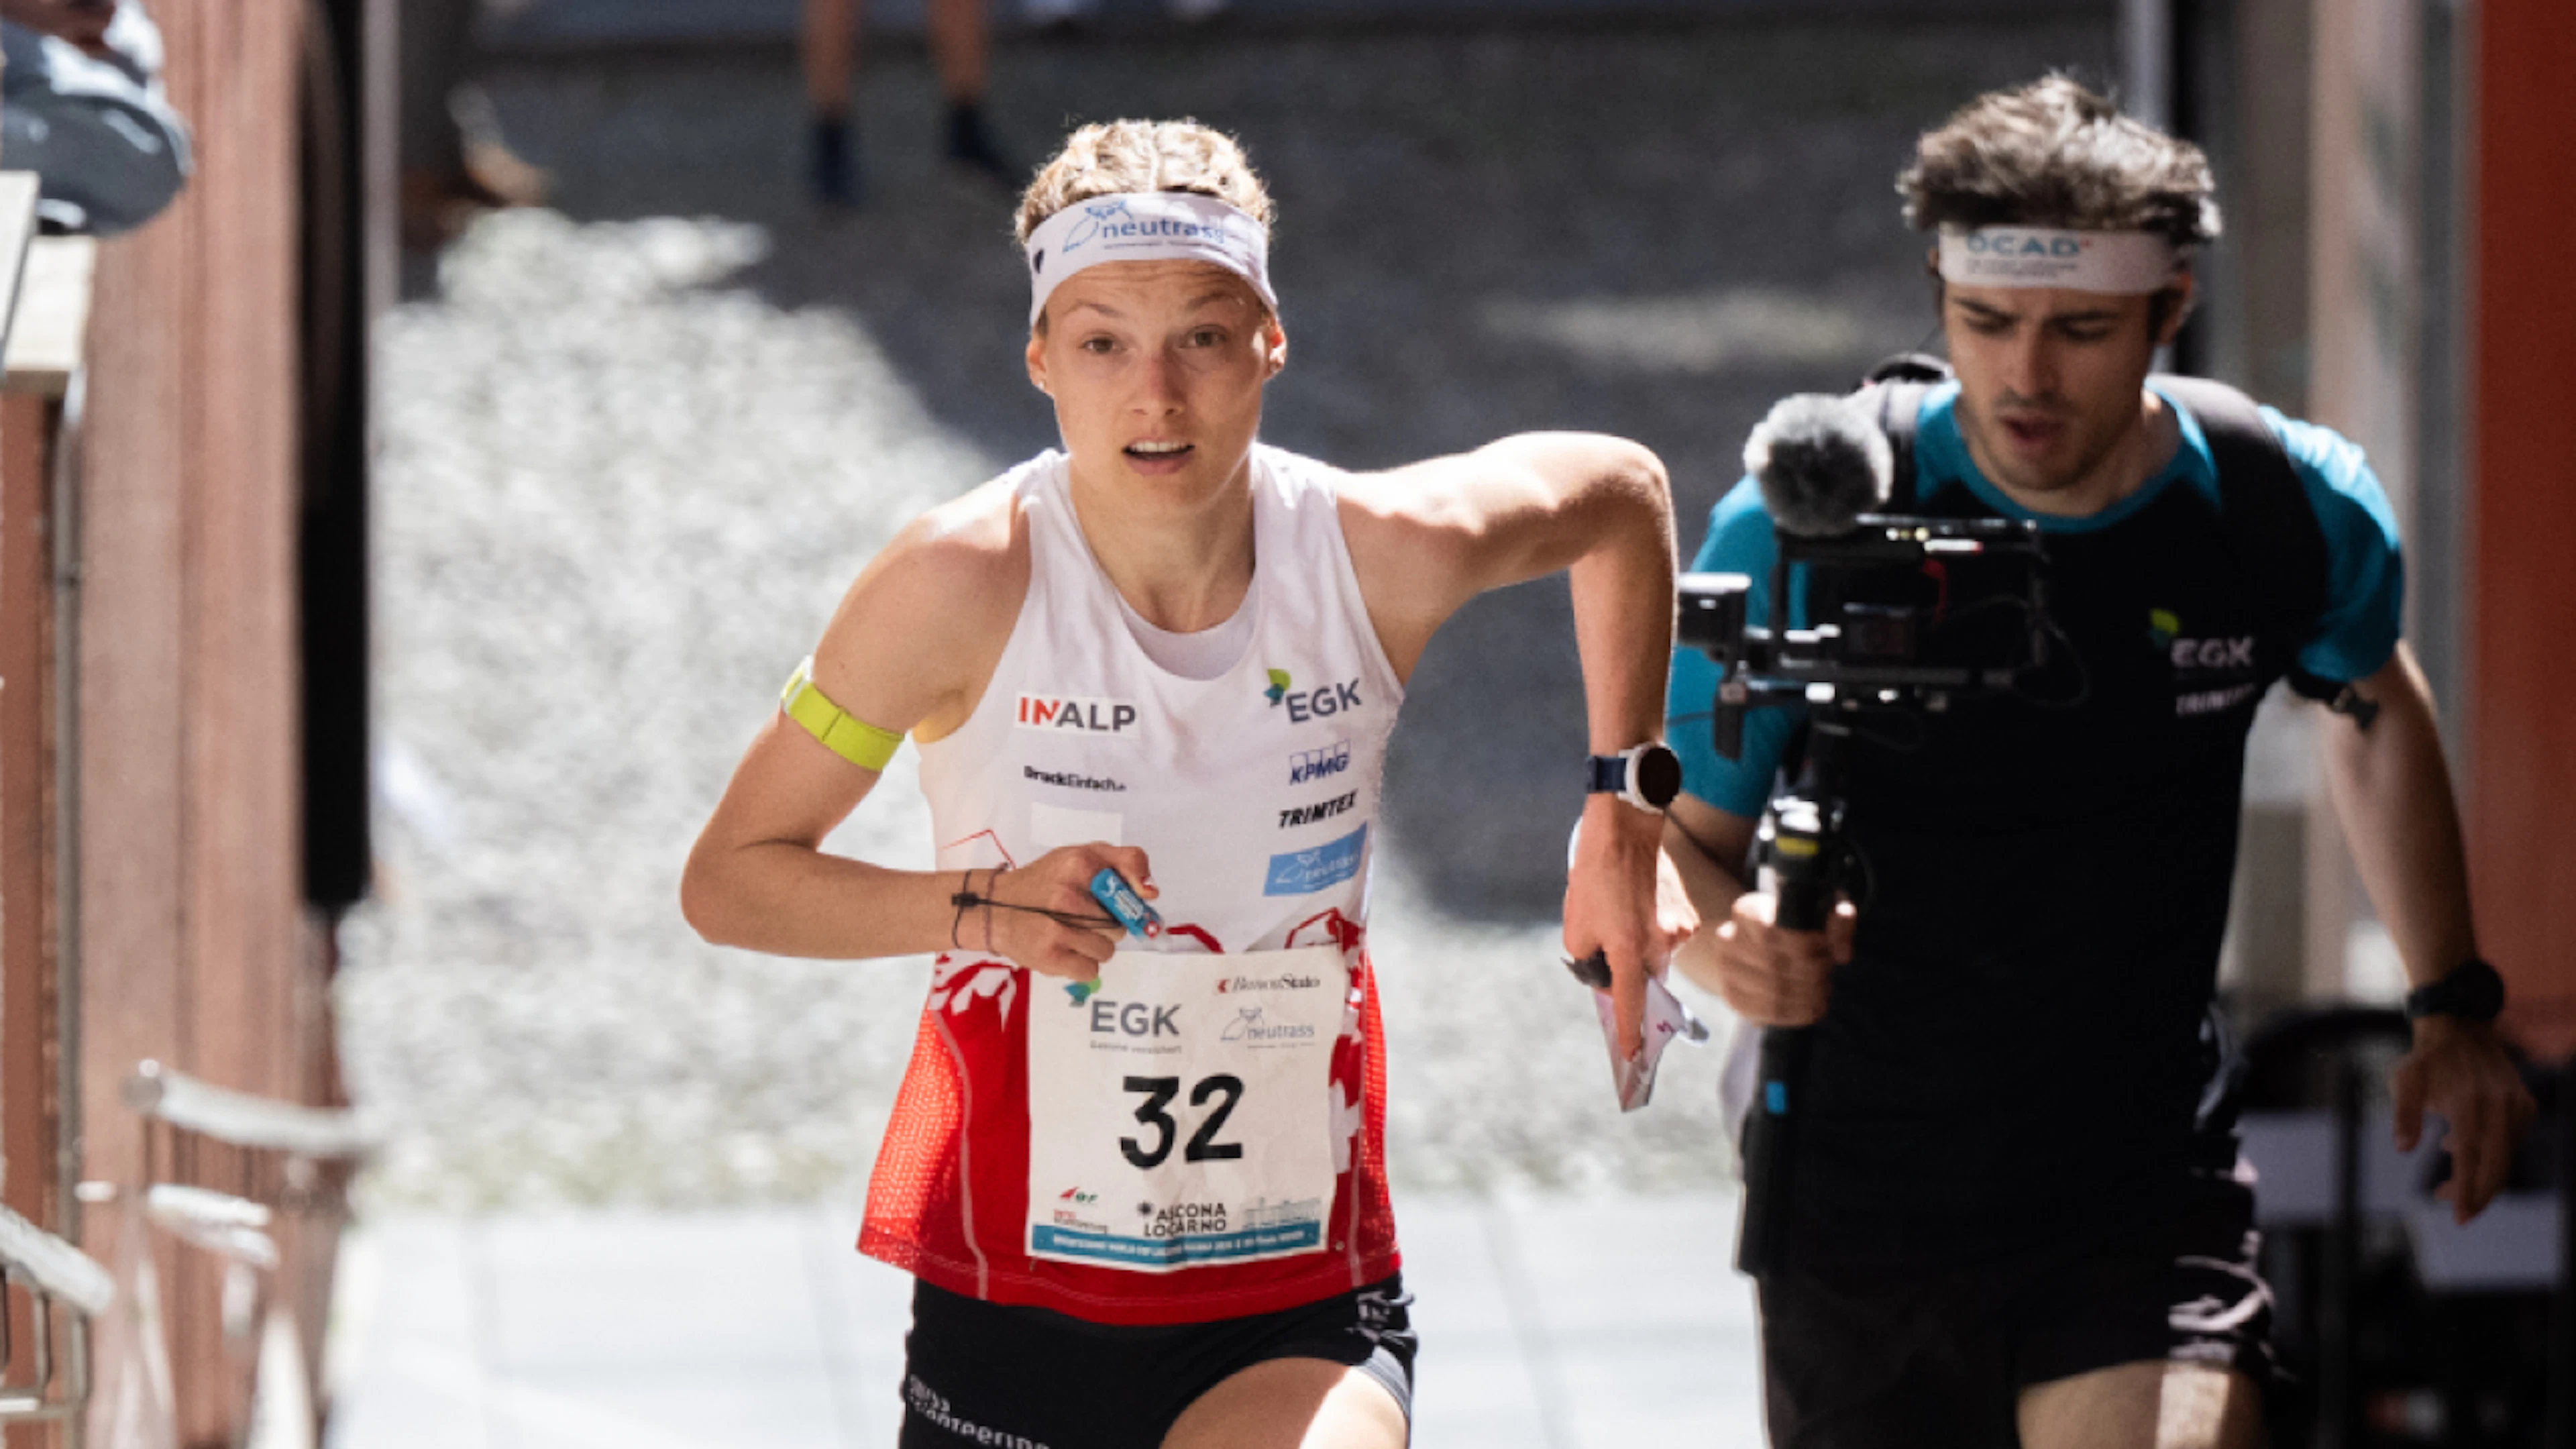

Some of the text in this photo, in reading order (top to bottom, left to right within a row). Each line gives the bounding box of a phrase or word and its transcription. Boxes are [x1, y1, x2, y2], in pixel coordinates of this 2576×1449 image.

[1966, 235, 2080, 256] OCAD
[1018, 696, 1136, 733] INALP
[1286, 677, 1362, 724] EGK
[1289, 753, 1350, 785] KPMG
[1279, 788, 1358, 829] TRIMTEX
[1091, 1000, 1182, 1038] EGK
[1248, 1024, 1315, 1040] neutrass
[1120, 1073, 1245, 1169] 32
